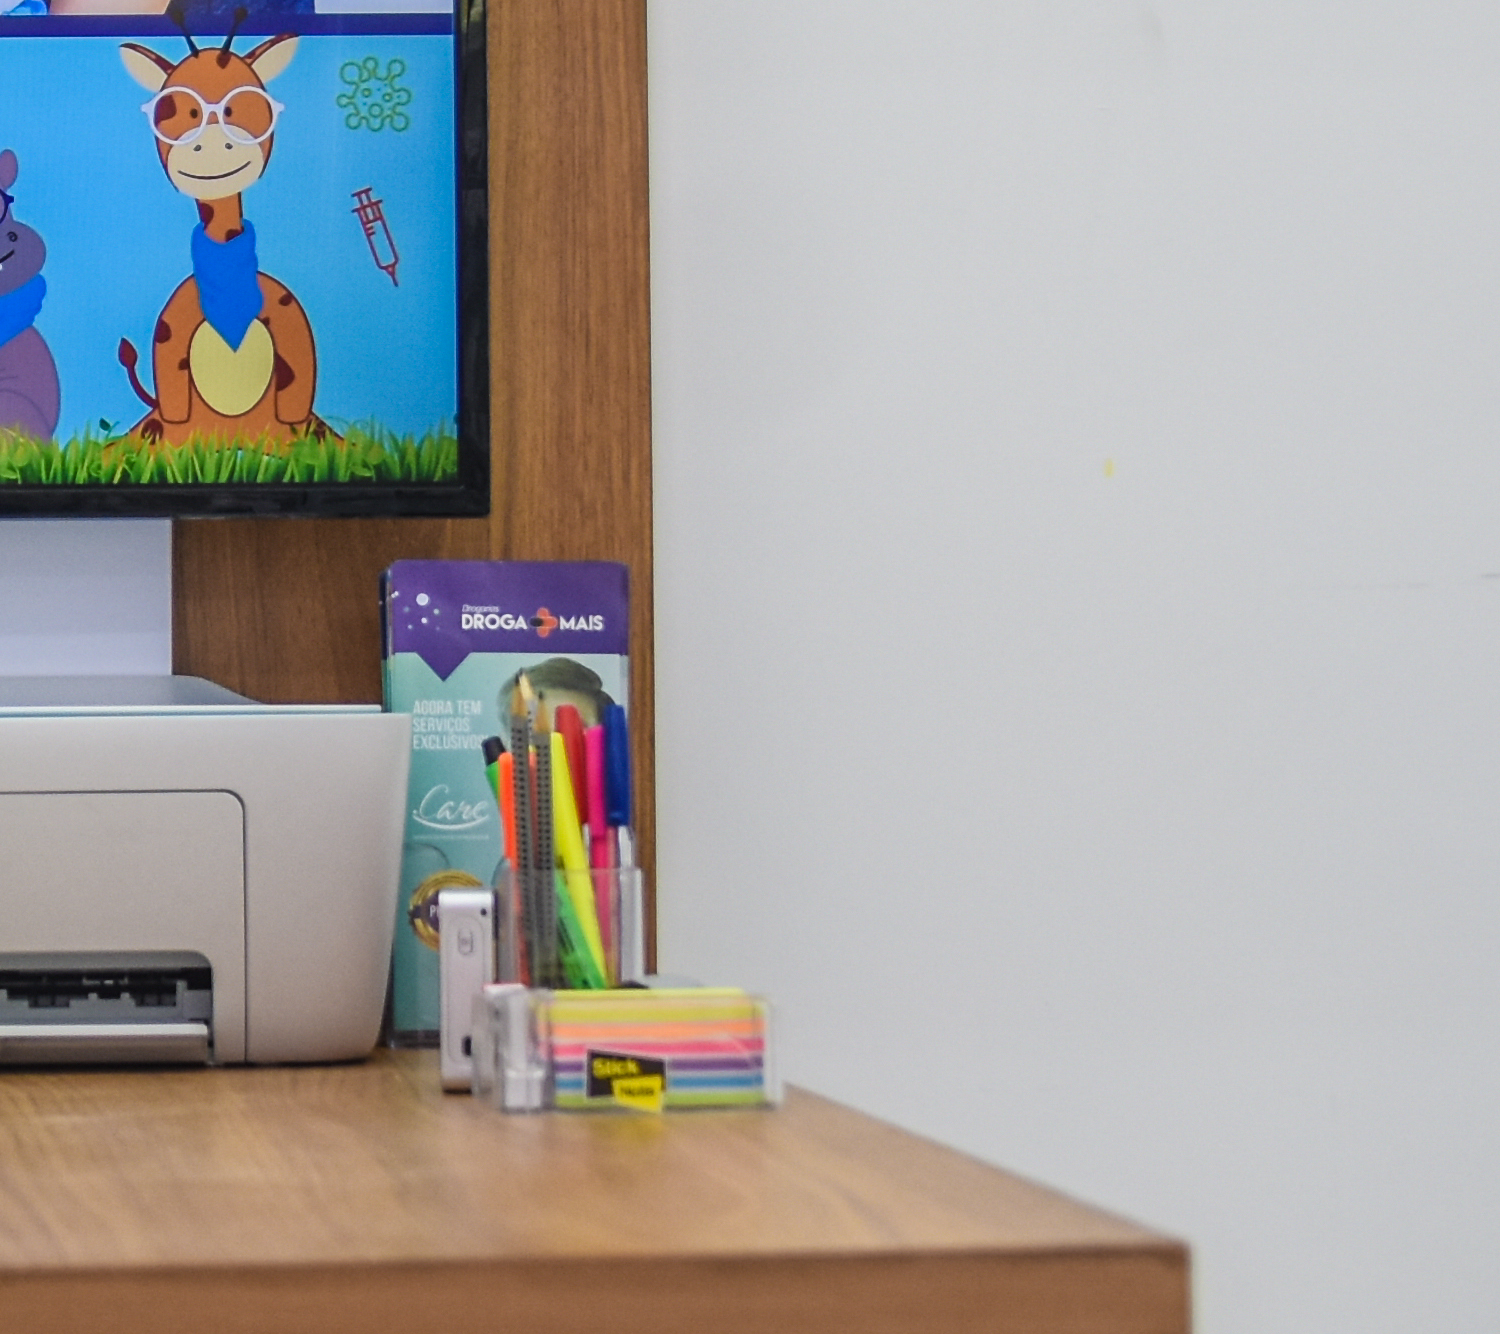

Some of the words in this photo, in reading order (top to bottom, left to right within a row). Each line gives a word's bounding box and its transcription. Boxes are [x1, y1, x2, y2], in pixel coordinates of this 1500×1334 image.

[461, 613, 528, 630] DROGA
[559, 615, 604, 631] MAIS
[457, 700, 482, 715] TEM
